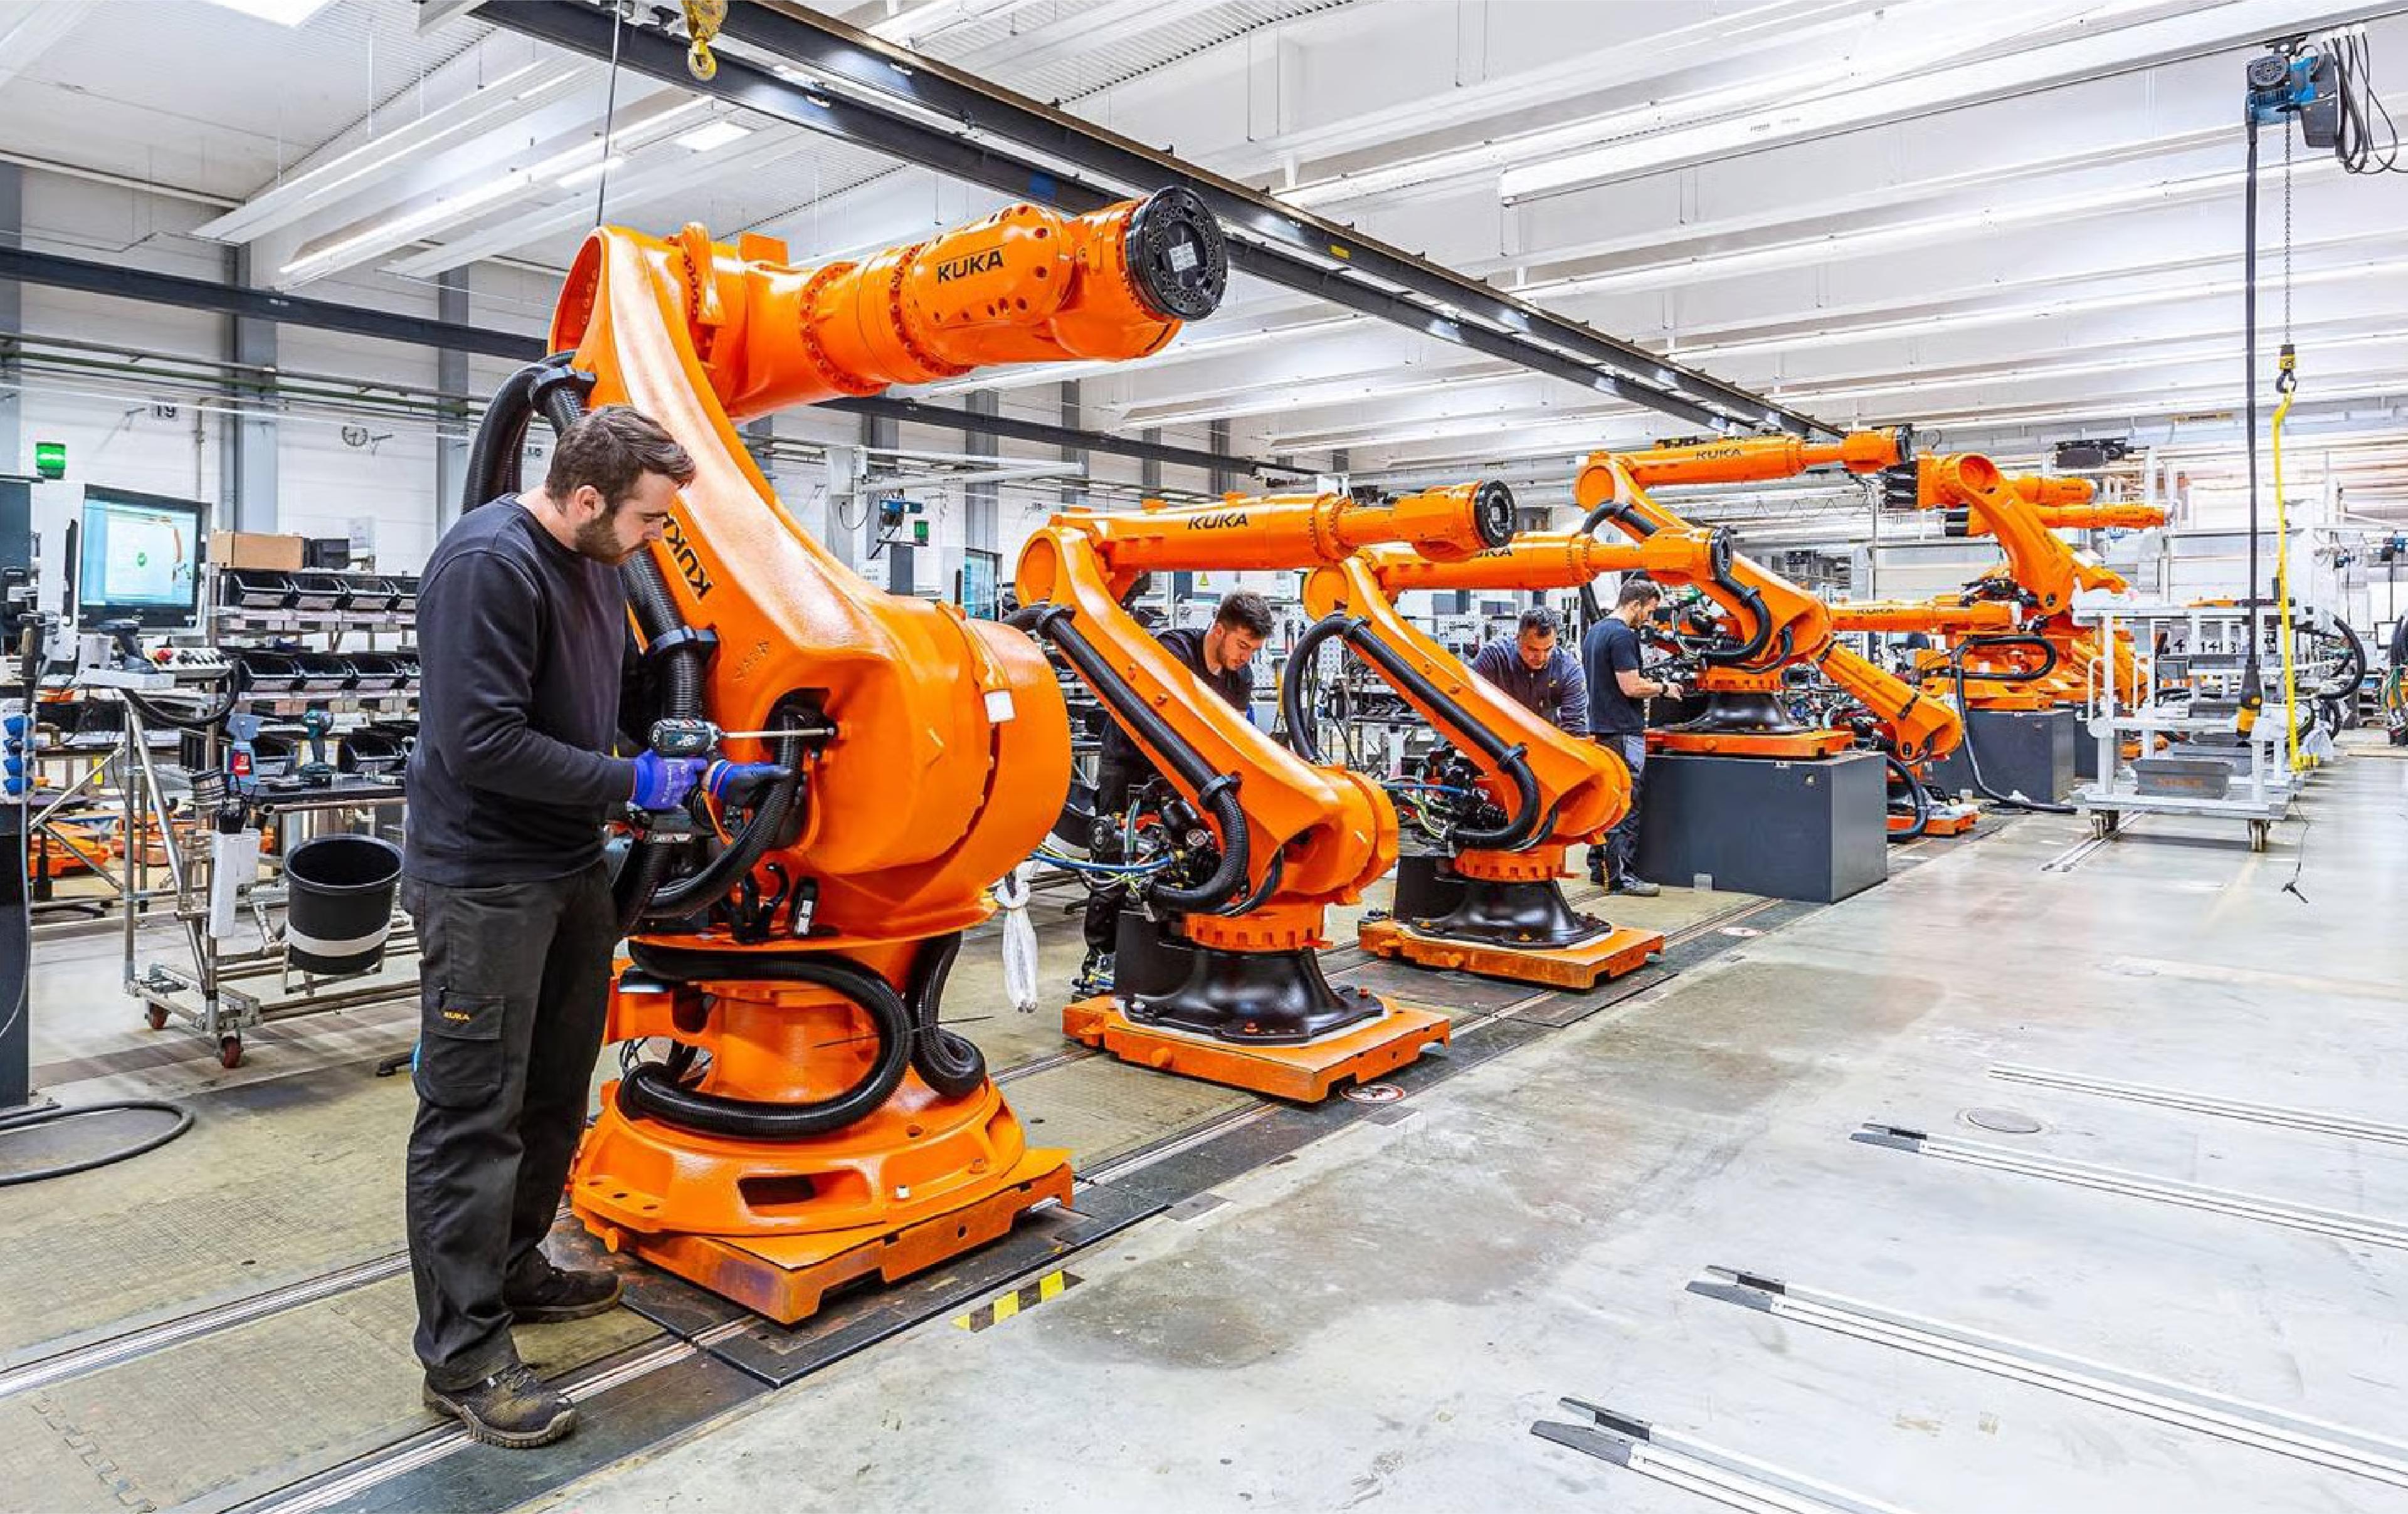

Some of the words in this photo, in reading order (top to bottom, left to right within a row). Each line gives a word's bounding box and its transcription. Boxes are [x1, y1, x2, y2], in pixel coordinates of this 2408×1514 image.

[937, 250, 1003, 284] KUKA
[1696, 448, 1741, 460] KUKA
[1188, 512, 1247, 530] KUKA
[662, 517, 713, 600] KUK
